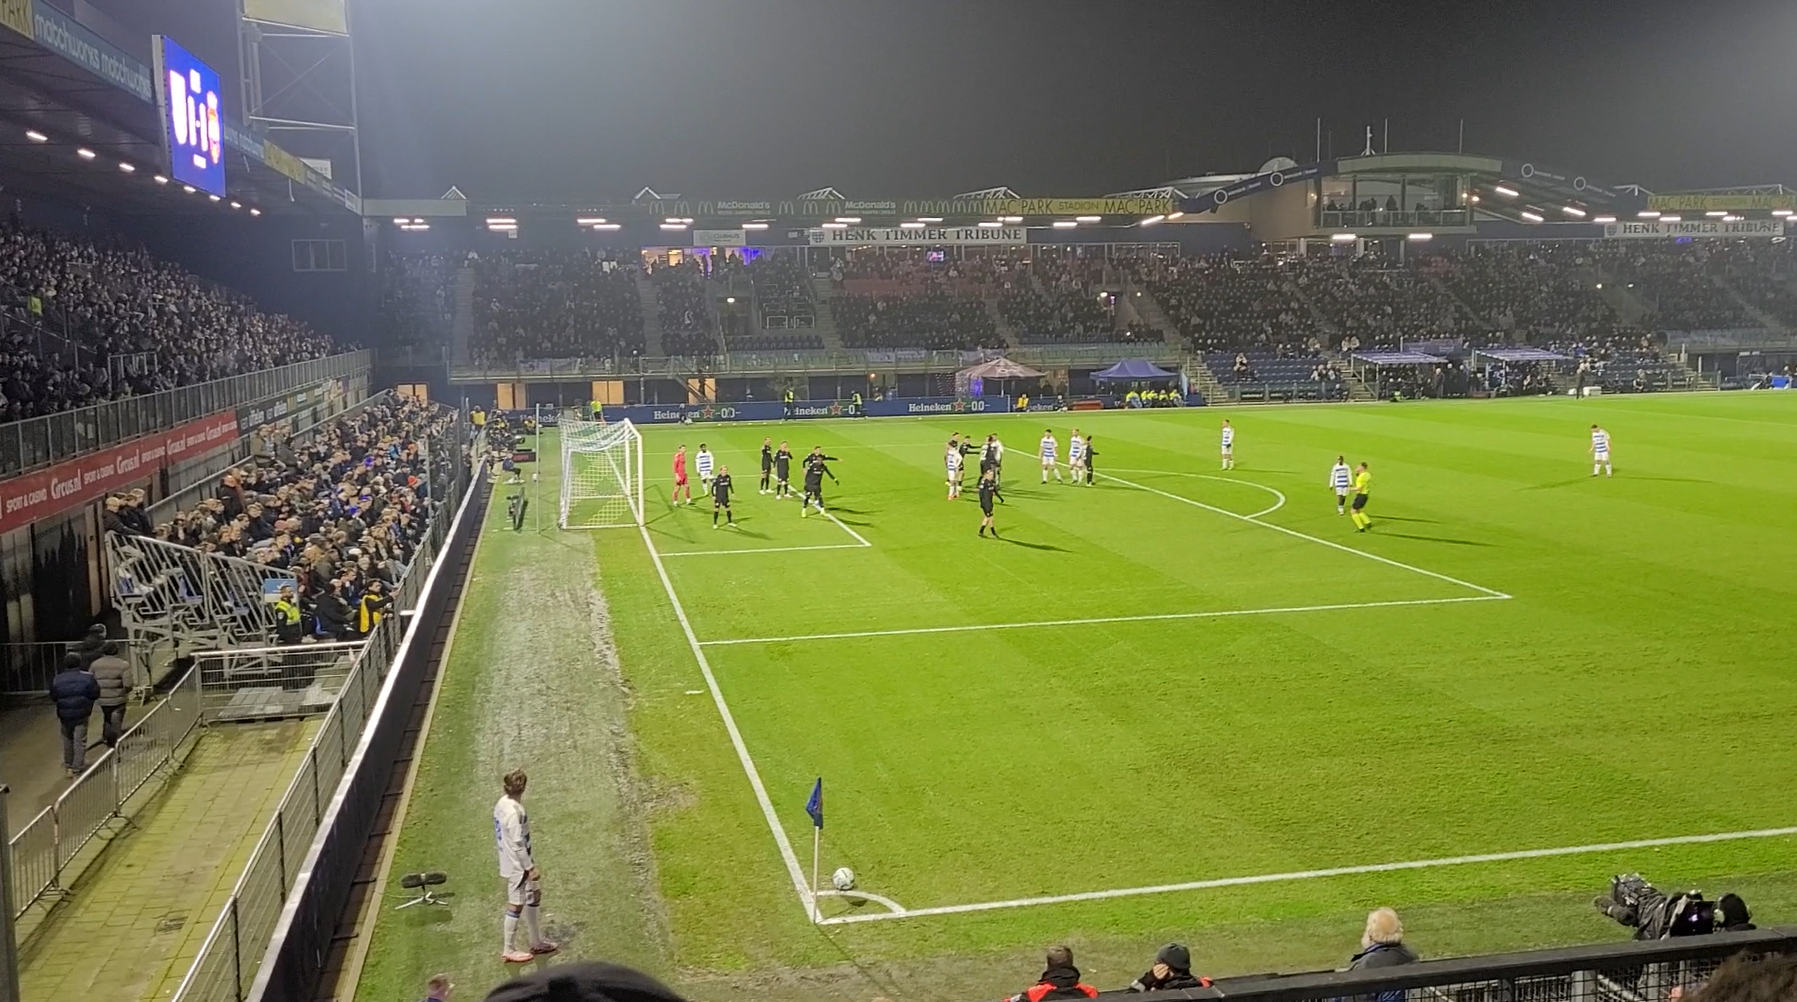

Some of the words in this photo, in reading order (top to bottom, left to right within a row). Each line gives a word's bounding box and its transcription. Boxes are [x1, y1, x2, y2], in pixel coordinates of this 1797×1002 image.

[718, 201, 770, 209] McDonald's
[845, 201, 895, 209] McDonald's
[1059, 201, 1099, 210] STADION
[1623, 222, 1659, 234] HENK
[1666, 222, 1717, 234] TIMMER
[1725, 222, 1779, 233] TRIBUNE
[832, 230, 877, 241] HENK
[883, 229, 947, 241] TIMMER
[955, 229, 1022, 240] TRIBUNE
[908, 403, 952, 412] Heineken
[6, 496, 22, 513] SPORT
[28, 488, 47, 505] CASINO
[51, 469, 82, 499] Circus.nl
